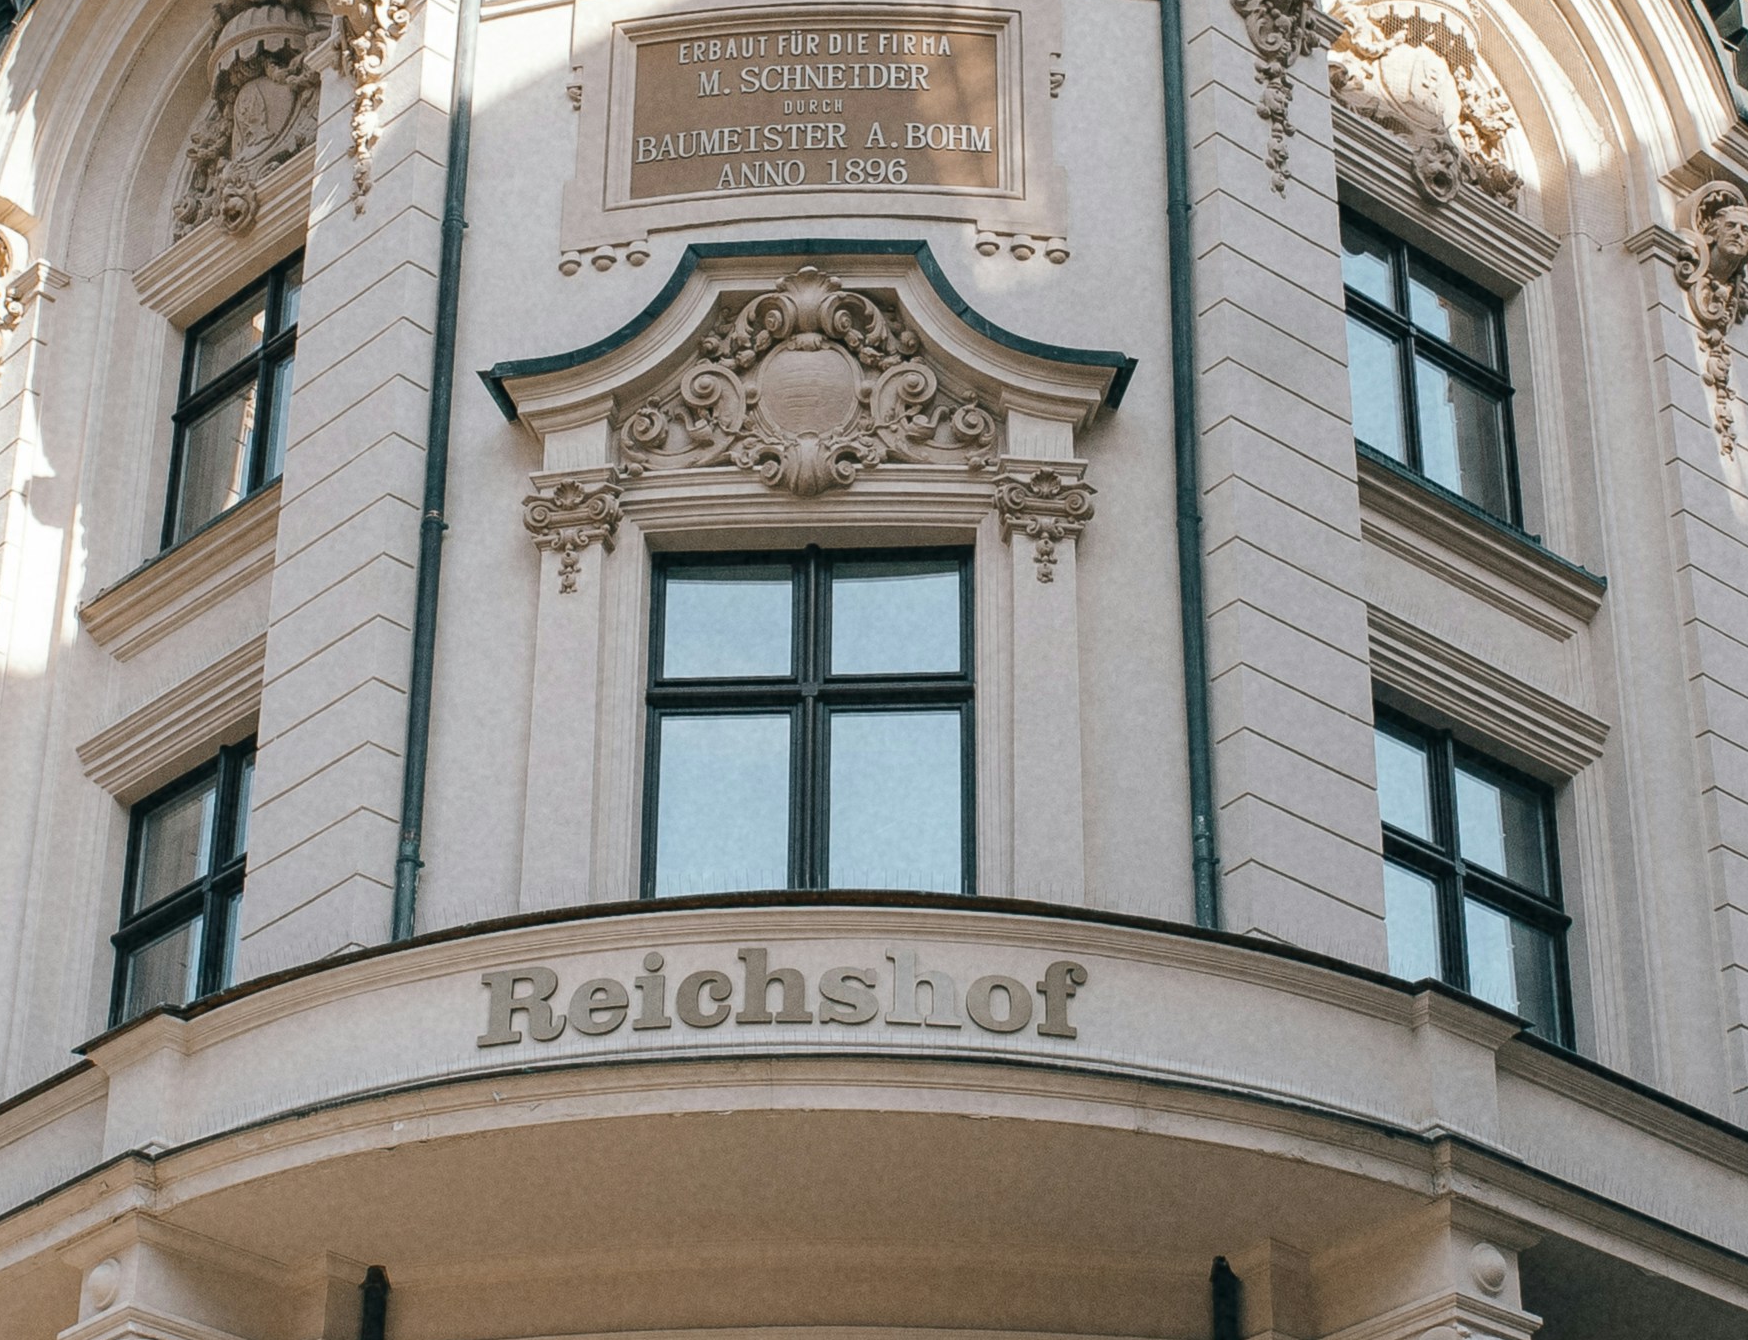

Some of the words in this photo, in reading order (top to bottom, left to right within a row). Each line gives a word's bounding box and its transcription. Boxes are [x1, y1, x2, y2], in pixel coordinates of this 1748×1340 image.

[678, 36, 768, 65] ERBAUT
[777, 30, 820, 56] FÜR
[828, 33, 869, 55] DIE
[878, 33, 952, 56] FIRMA
[697, 69, 732, 97] M.
[739, 63, 931, 94] SCHNEIDER
[784, 98, 844, 115] DURCH
[635, 122, 849, 164] BAUMEISTER
[714, 159, 806, 192] ANNO
[826, 157, 909, 185] 1896
[477, 947, 1088, 1049] Reichshof
